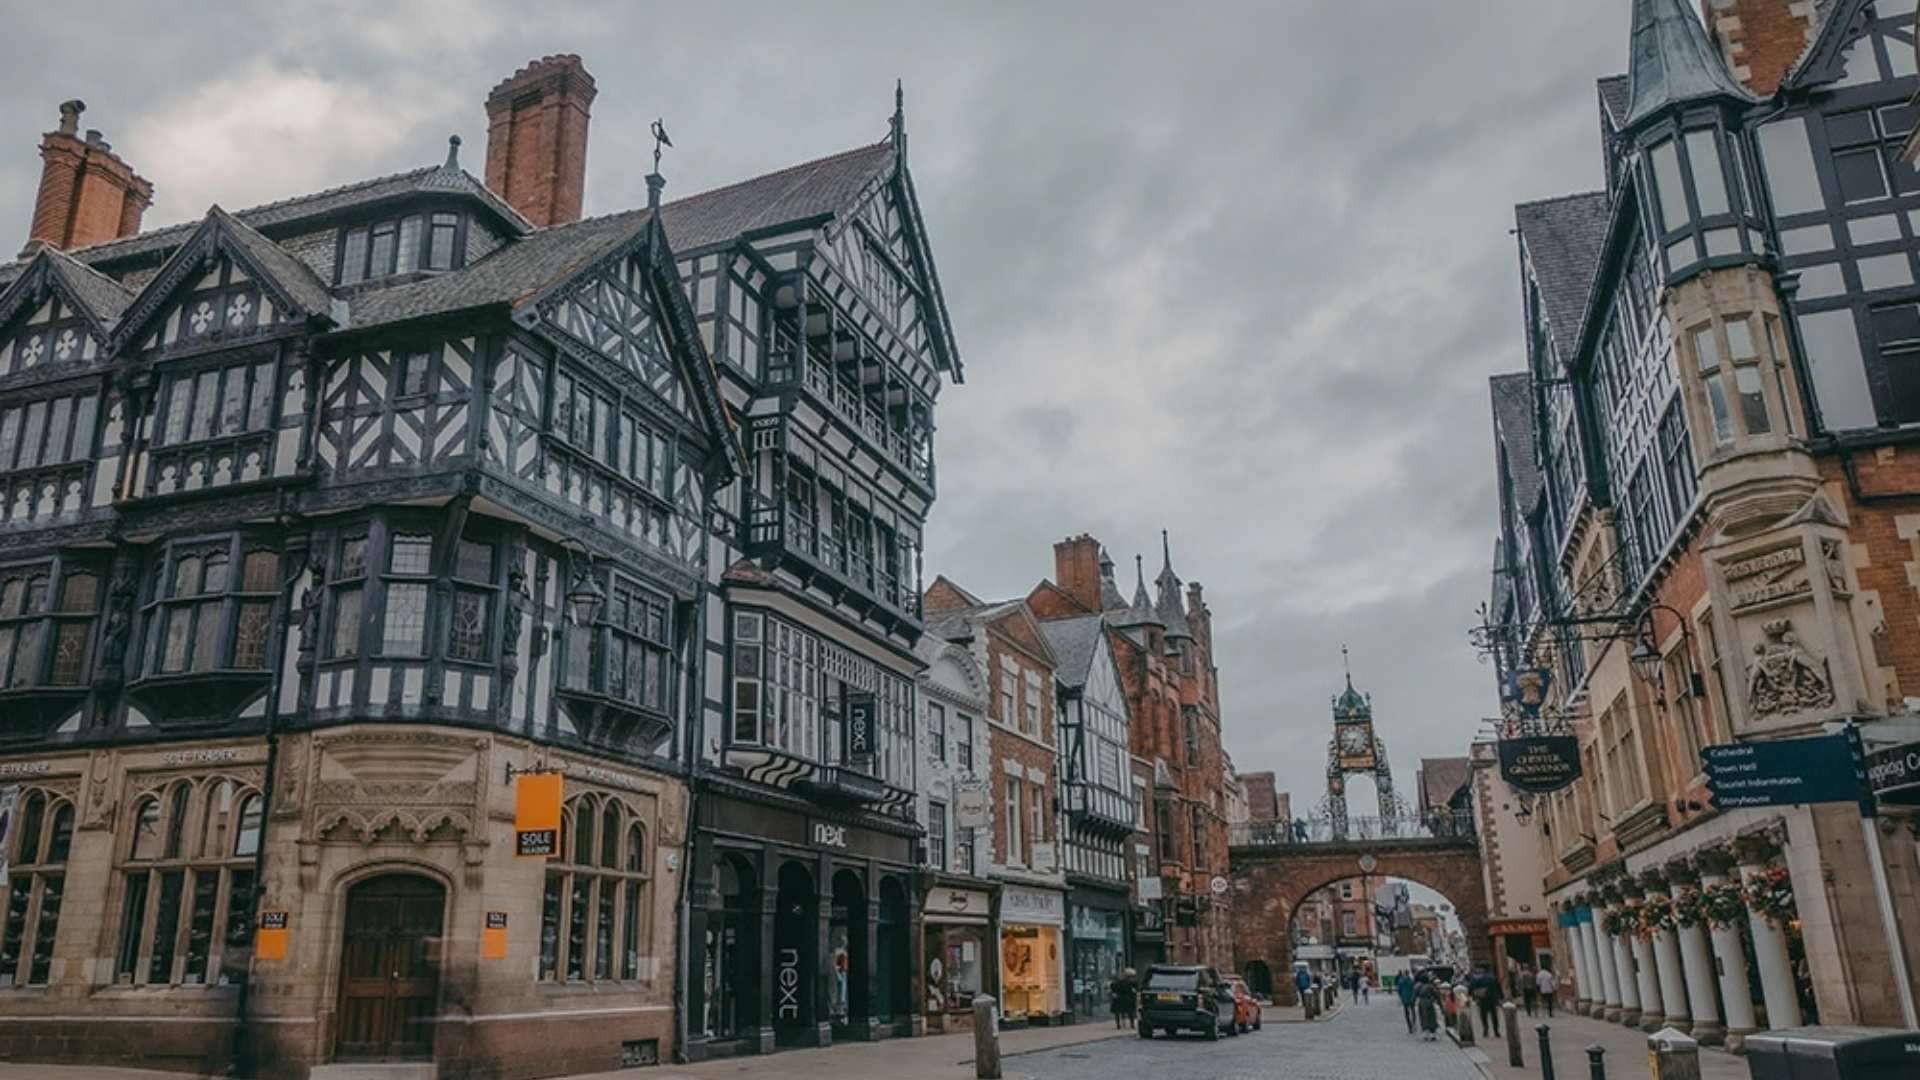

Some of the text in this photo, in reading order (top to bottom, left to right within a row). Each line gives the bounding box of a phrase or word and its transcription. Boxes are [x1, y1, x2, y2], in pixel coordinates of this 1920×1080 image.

[853, 708, 866, 750] next
[1710, 746, 1754, 757] Cathedral
[1712, 762, 1757, 773] Town Hall
[1906, 752, 1920, 770] C
[1715, 776, 1803, 789] Tourist Information
[1719, 795, 1770, 806] Storyhouse
[520, 831, 552, 845] SOLE
[815, 823, 847, 848] next
[779, 948, 799, 1019] next
